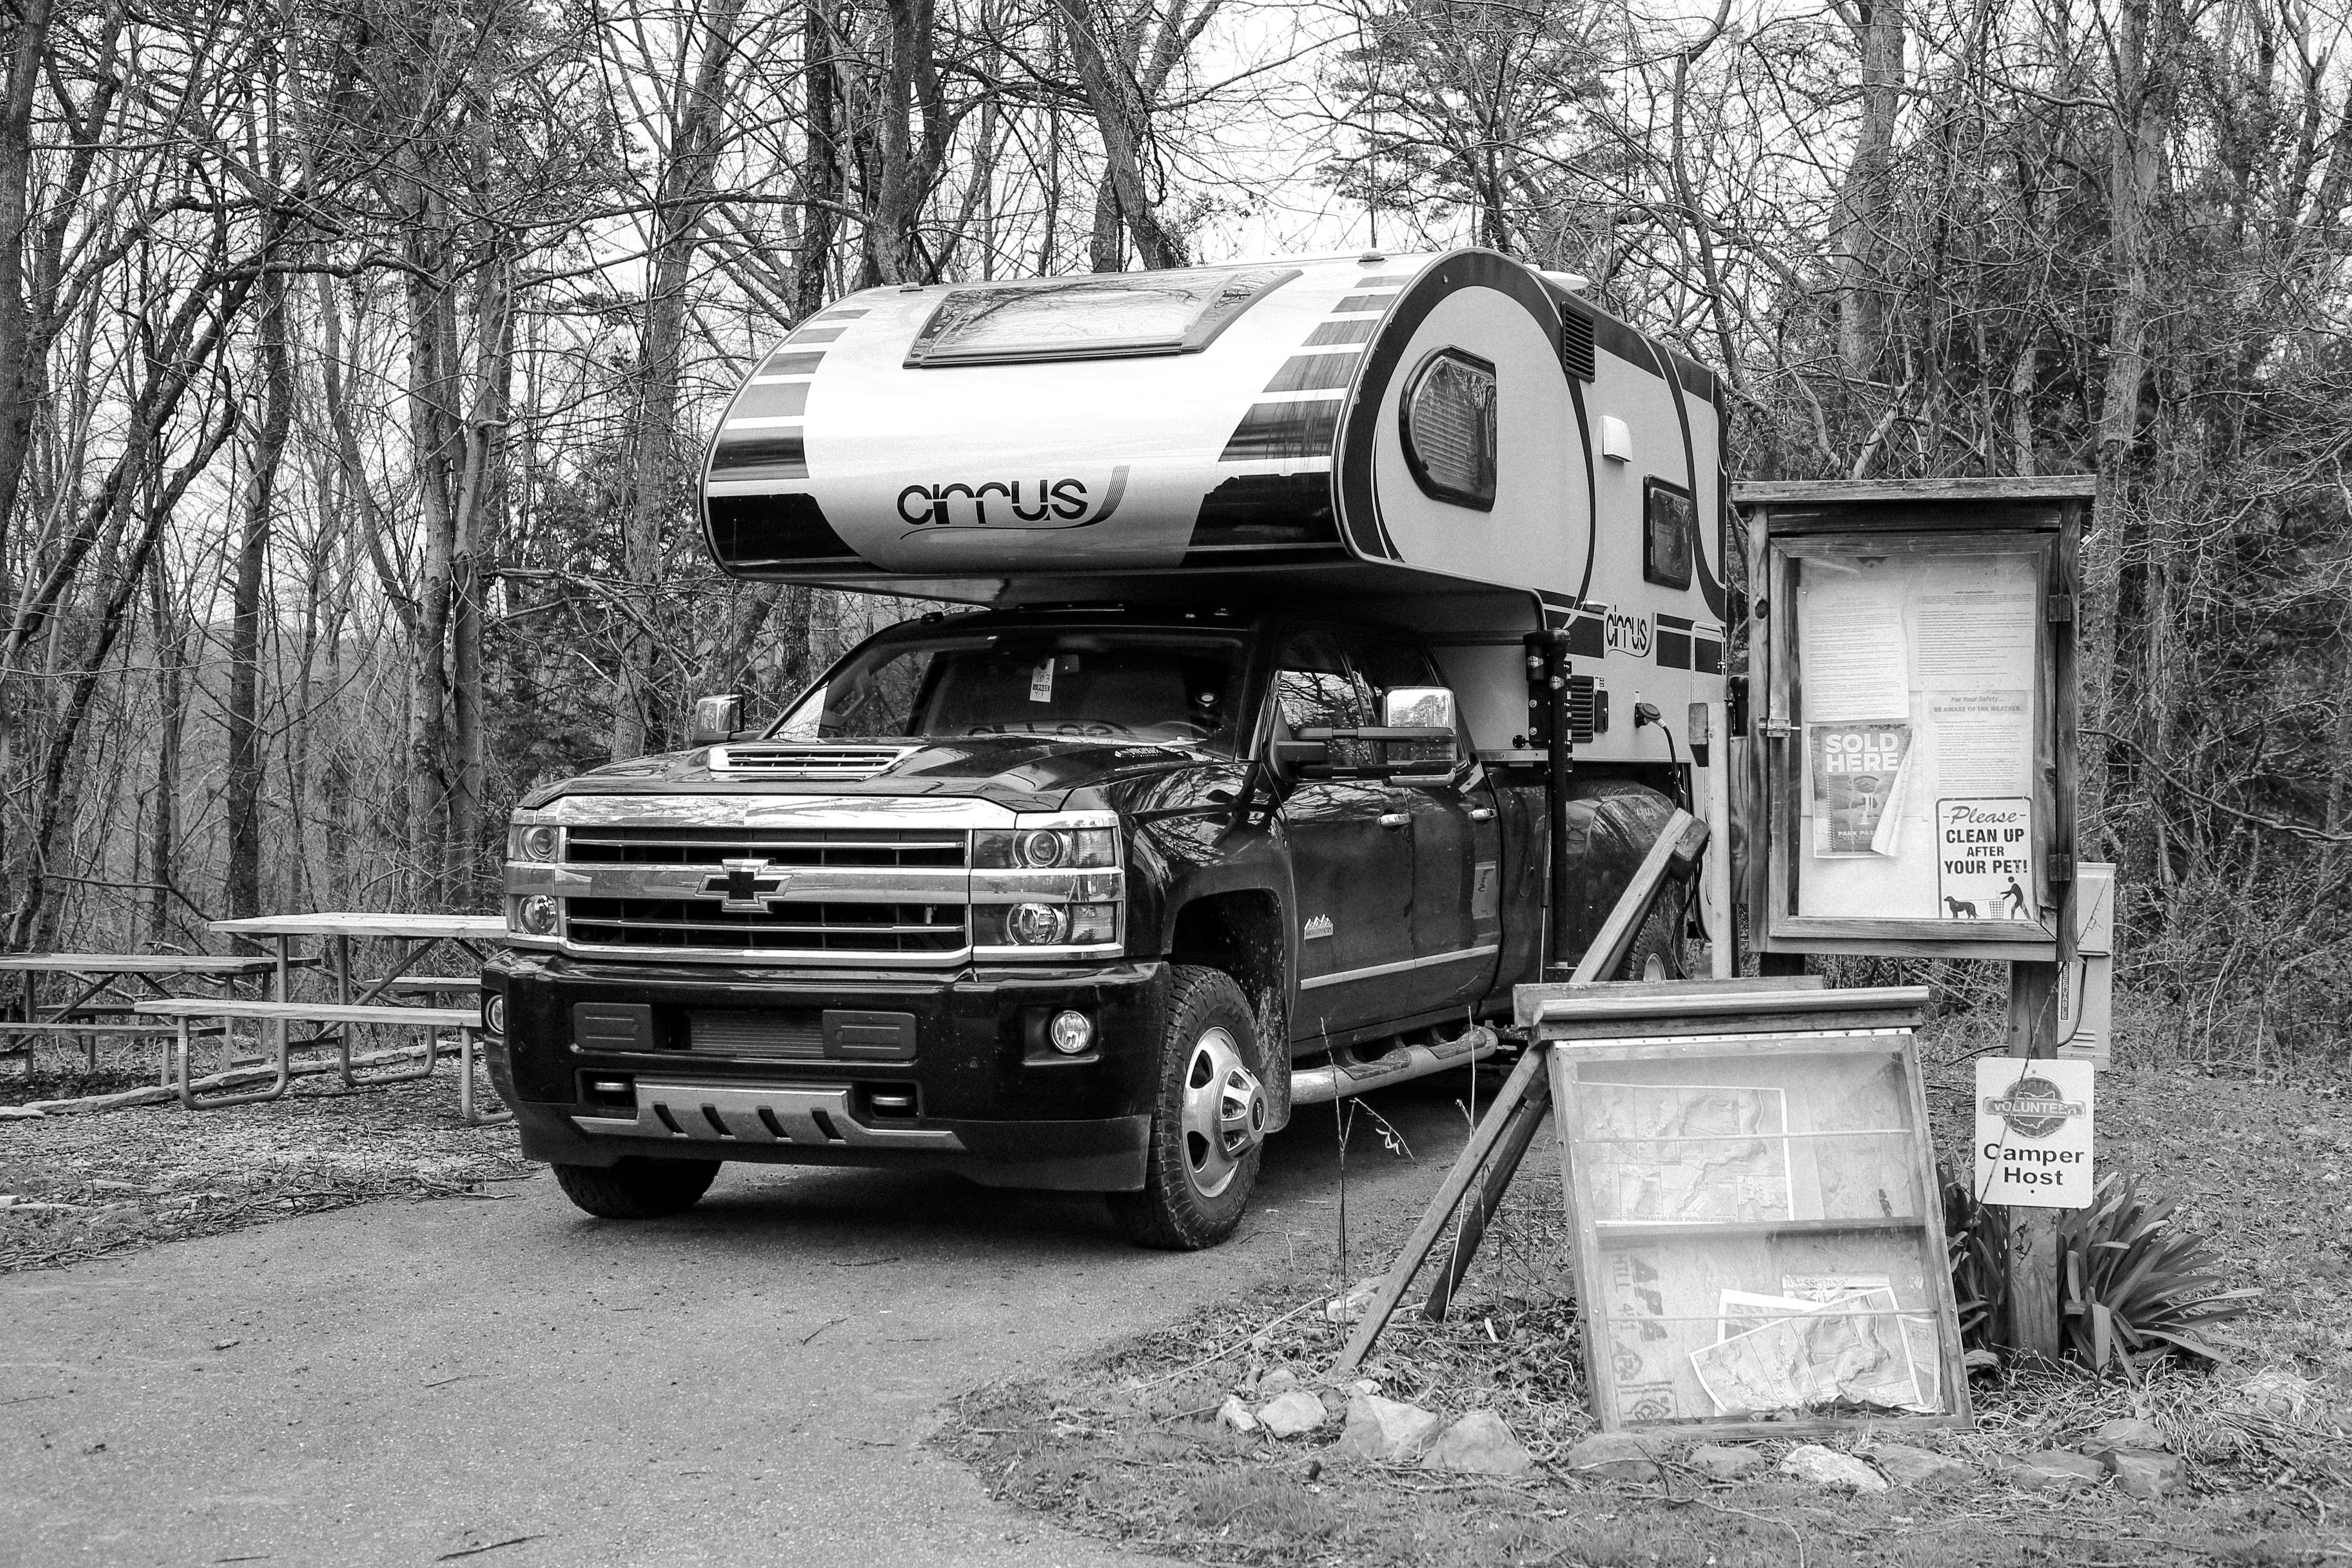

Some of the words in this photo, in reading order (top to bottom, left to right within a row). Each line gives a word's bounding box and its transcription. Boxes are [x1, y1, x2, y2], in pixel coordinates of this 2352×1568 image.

[897, 478, 1088, 525] cirrus
[1606, 604, 1647, 651] cirrus
[1826, 733, 1899, 753] SOLD
[1827, 753, 1899, 772] HERE
[1950, 805, 2018, 825] Please
[1946, 829, 1997, 843] CLEAN
[2004, 828, 2024, 842] UP
[1967, 846, 2004, 857] AFTER
[1944, 860, 1987, 874] YOUR
[1993, 860, 2028, 873] PET!
[1994, 1101, 2077, 1115] VOLUNTEER
[1984, 1143, 2084, 1166] Camper
[2004, 1167, 2063, 1186] Host
